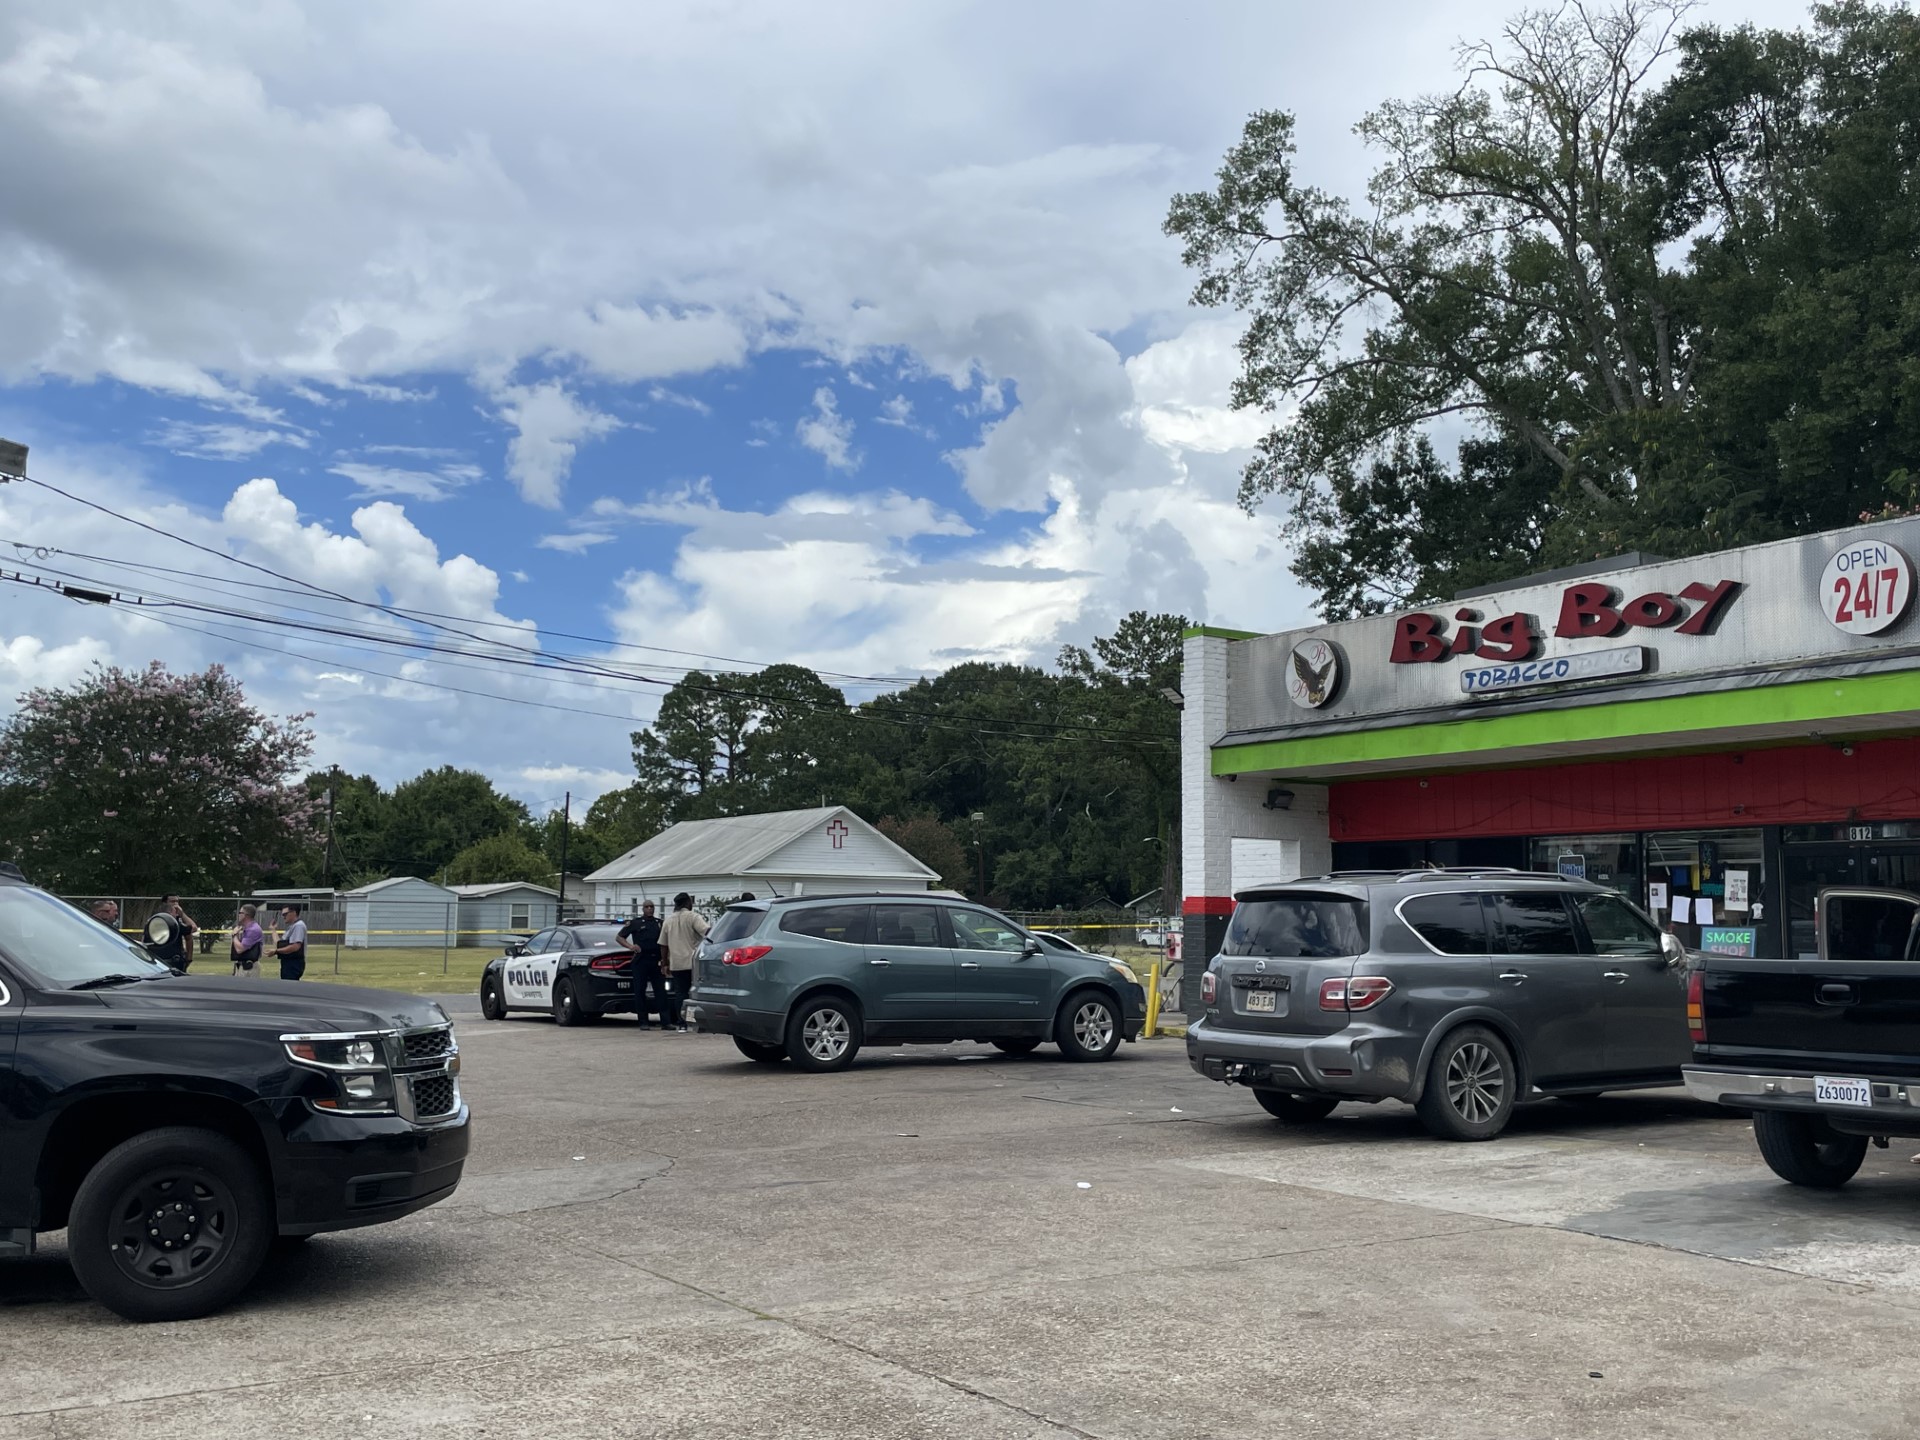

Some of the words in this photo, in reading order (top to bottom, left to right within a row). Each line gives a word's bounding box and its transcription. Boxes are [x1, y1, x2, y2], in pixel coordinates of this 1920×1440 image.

[1836, 546, 1887, 572] OPEN
[1833, 567, 1899, 624] 24/7
[1389, 607, 1535, 663] Big
[1465, 659, 1570, 690] TOBACCO
[1850, 827, 1871, 840] 812
[1706, 932, 1751, 944] SMOKE
[1710, 945, 1747, 956] SHOP
[507, 970, 549, 986] POLICE
[1817, 1085, 1868, 1102] Z630072
